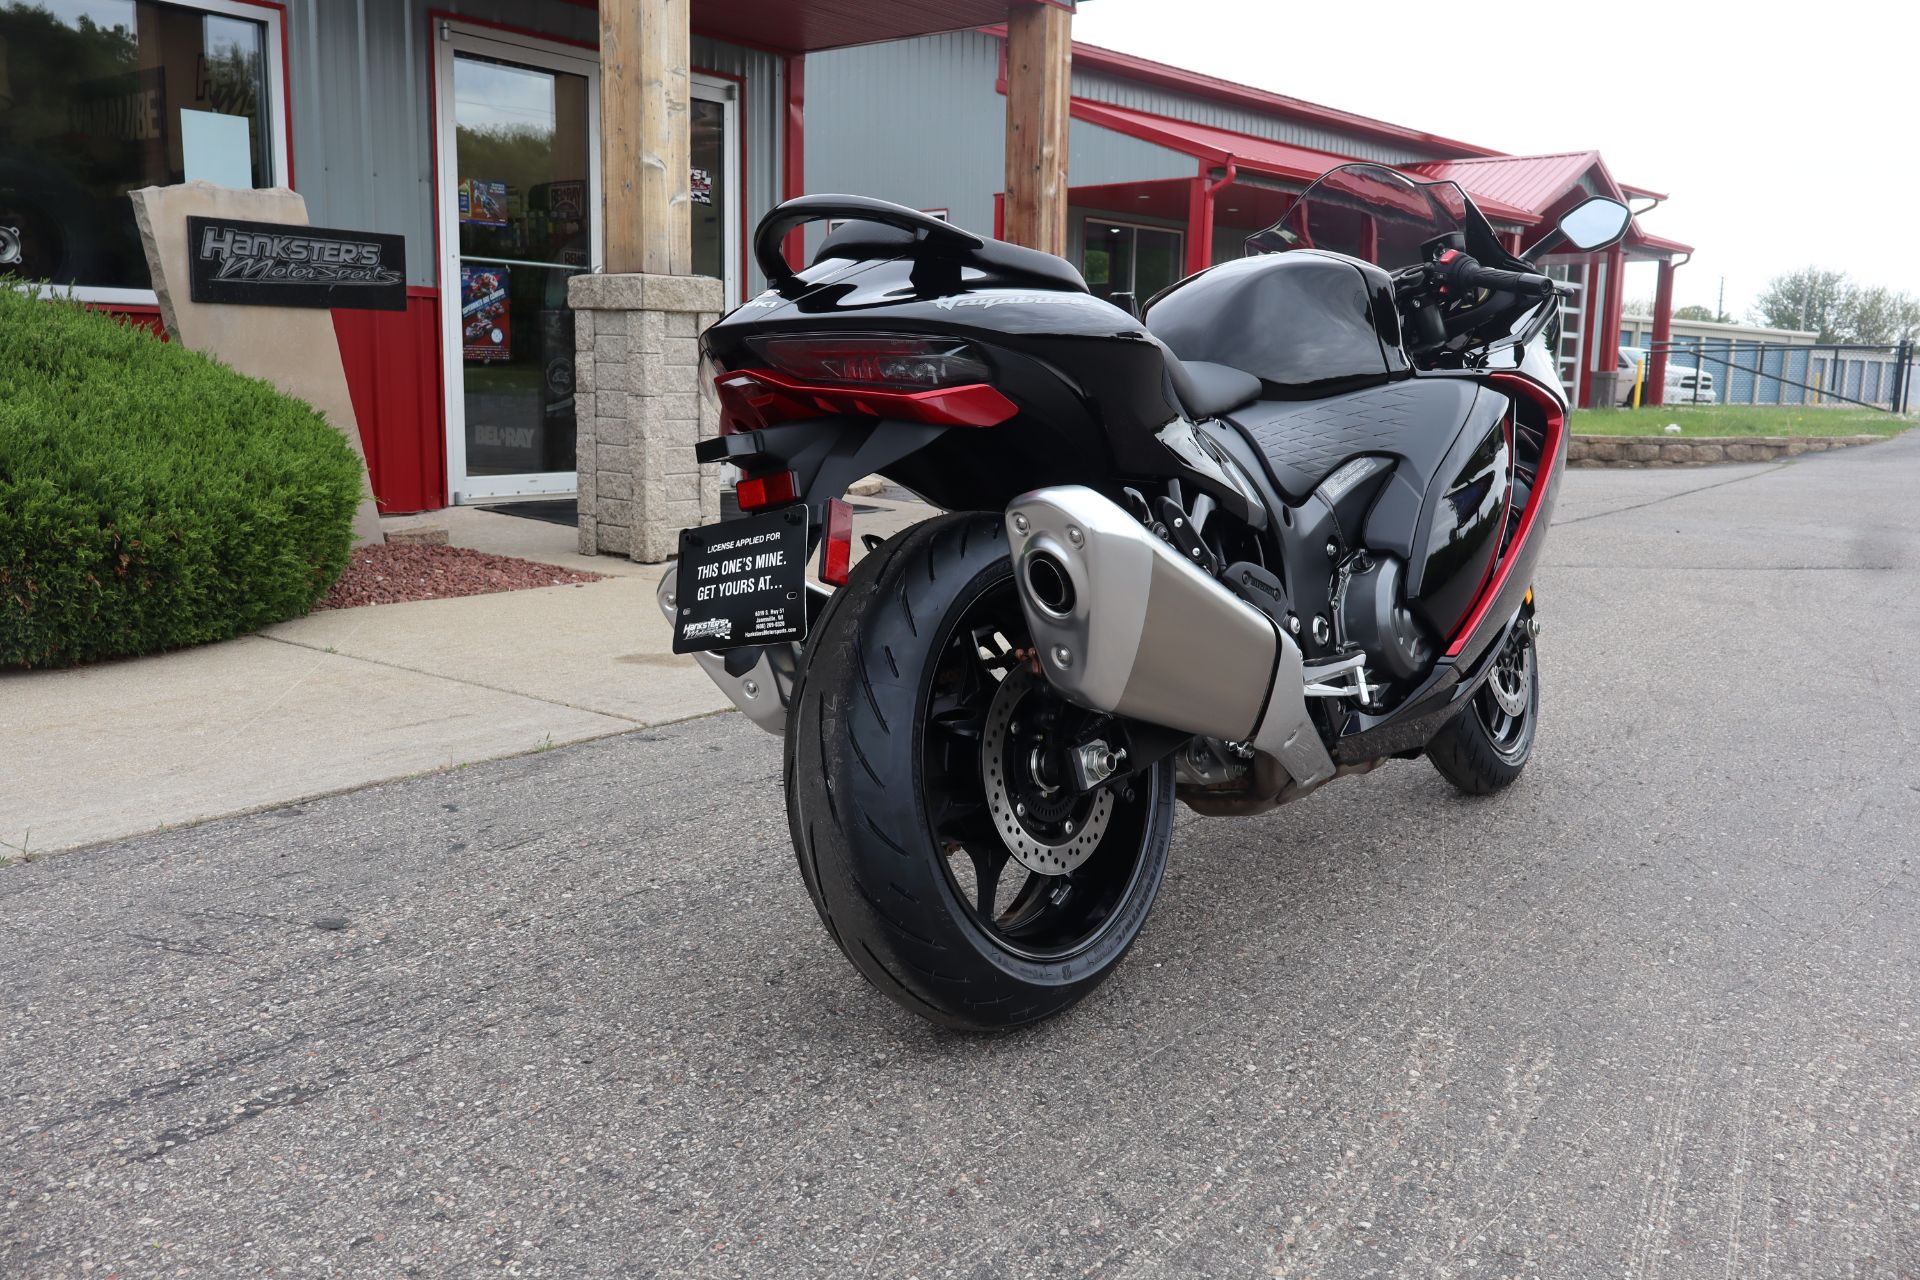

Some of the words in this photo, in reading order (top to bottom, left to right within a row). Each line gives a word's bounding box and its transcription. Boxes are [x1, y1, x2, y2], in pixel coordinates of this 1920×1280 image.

[707, 540, 735, 554] LICENSE
[735, 534, 765, 548] APPLIED
[765, 531, 781, 542] FOR
[697, 562, 719, 580] THIS
[721, 556, 753, 576] ONE'S
[755, 550, 787, 570] MINE.
[697, 584, 717, 601] GET
[719, 577, 755, 598] YOURS
[757, 575, 783, 592] AT...
